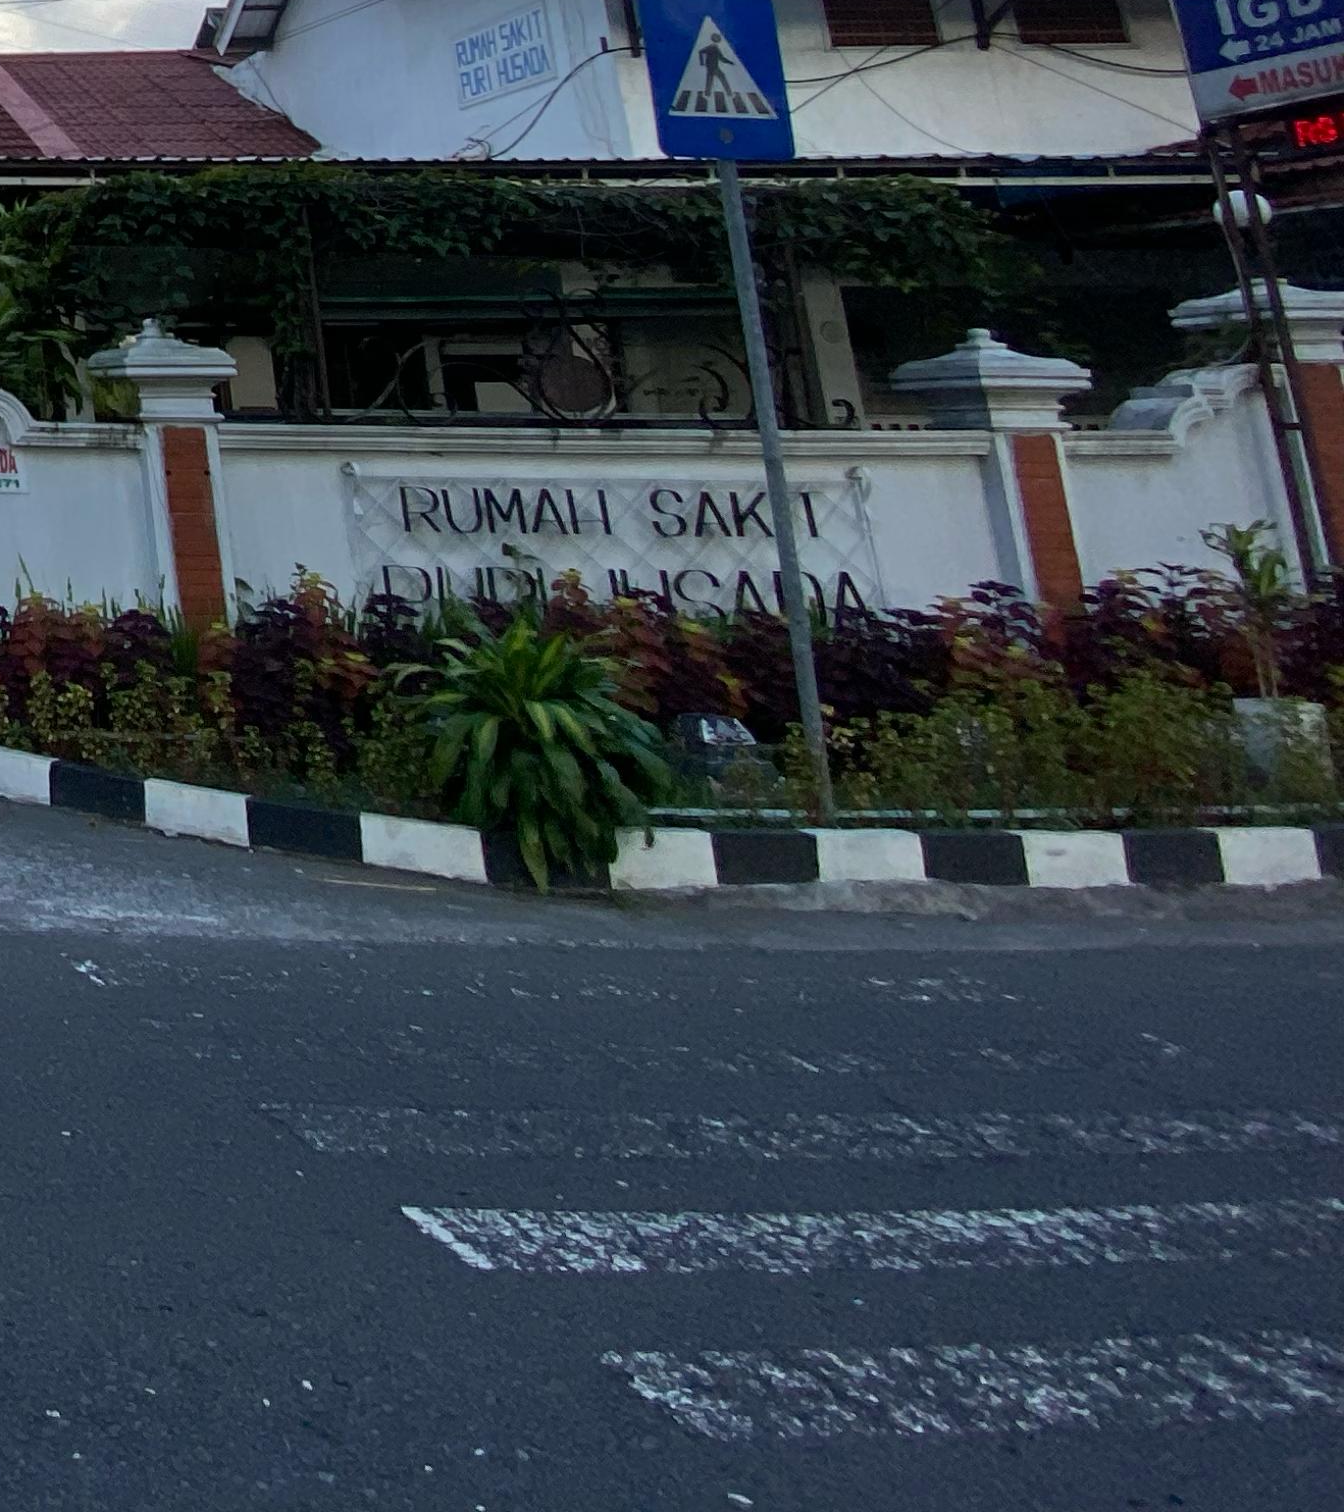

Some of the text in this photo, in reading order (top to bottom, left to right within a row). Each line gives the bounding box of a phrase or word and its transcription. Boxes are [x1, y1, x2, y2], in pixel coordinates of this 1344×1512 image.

[455, 9, 542, 68] RUMAH SAKIT
[1255, 18, 1343, 51] 24 JAM
[459, 44, 551, 99] PURI HUSADA
[399, 485, 820, 538] RUMAH SAKT
